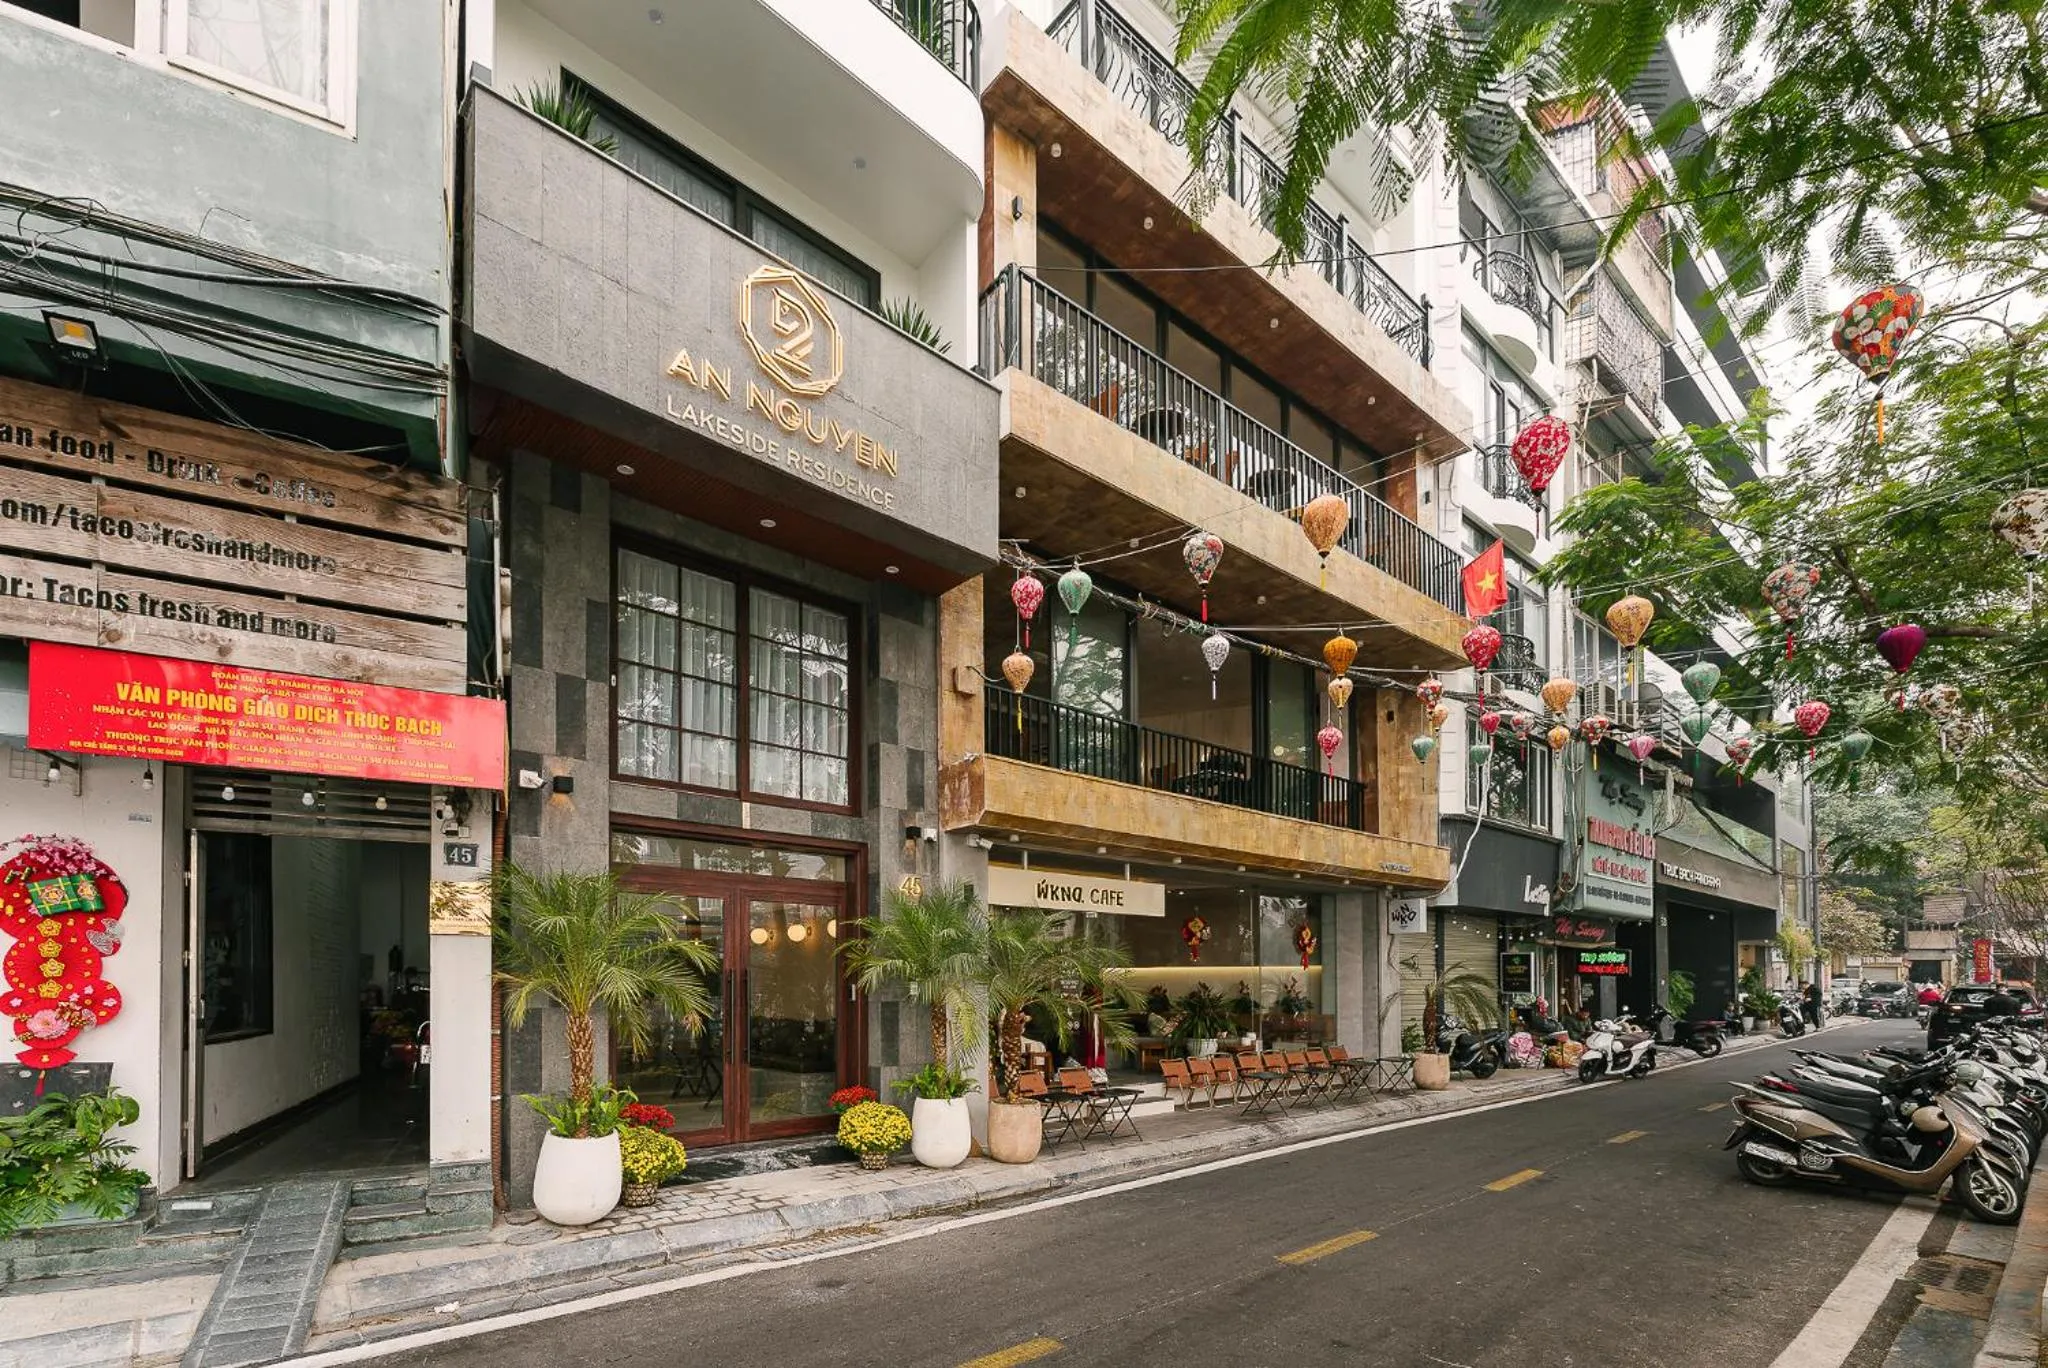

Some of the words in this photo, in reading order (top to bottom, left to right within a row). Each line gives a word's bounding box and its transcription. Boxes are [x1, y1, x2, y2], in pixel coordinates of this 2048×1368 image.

[667, 347, 732, 401] AN
[746, 378, 898, 479] NGUYEN
[49, 429, 114, 464] food
[147, 449, 221, 487] Drink
[667, 394, 782, 461] LAKESIDE
[786, 445, 895, 510] RESIDENCE
[43, 577, 130, 613] Tacos
[138, 592, 210, 626] fresh
[217, 607, 265, 633] and
[271, 616, 336, 644] more
[116, 681, 161, 705] VĂN
[166, 688, 237, 714] PHÒNG
[294, 704, 340, 725] DỊCH
[344, 709, 391, 731] TRÚC
[449, 846, 472, 864] 45
[901, 876, 924, 897] 45
[1090, 887, 1125, 907] CAFE
